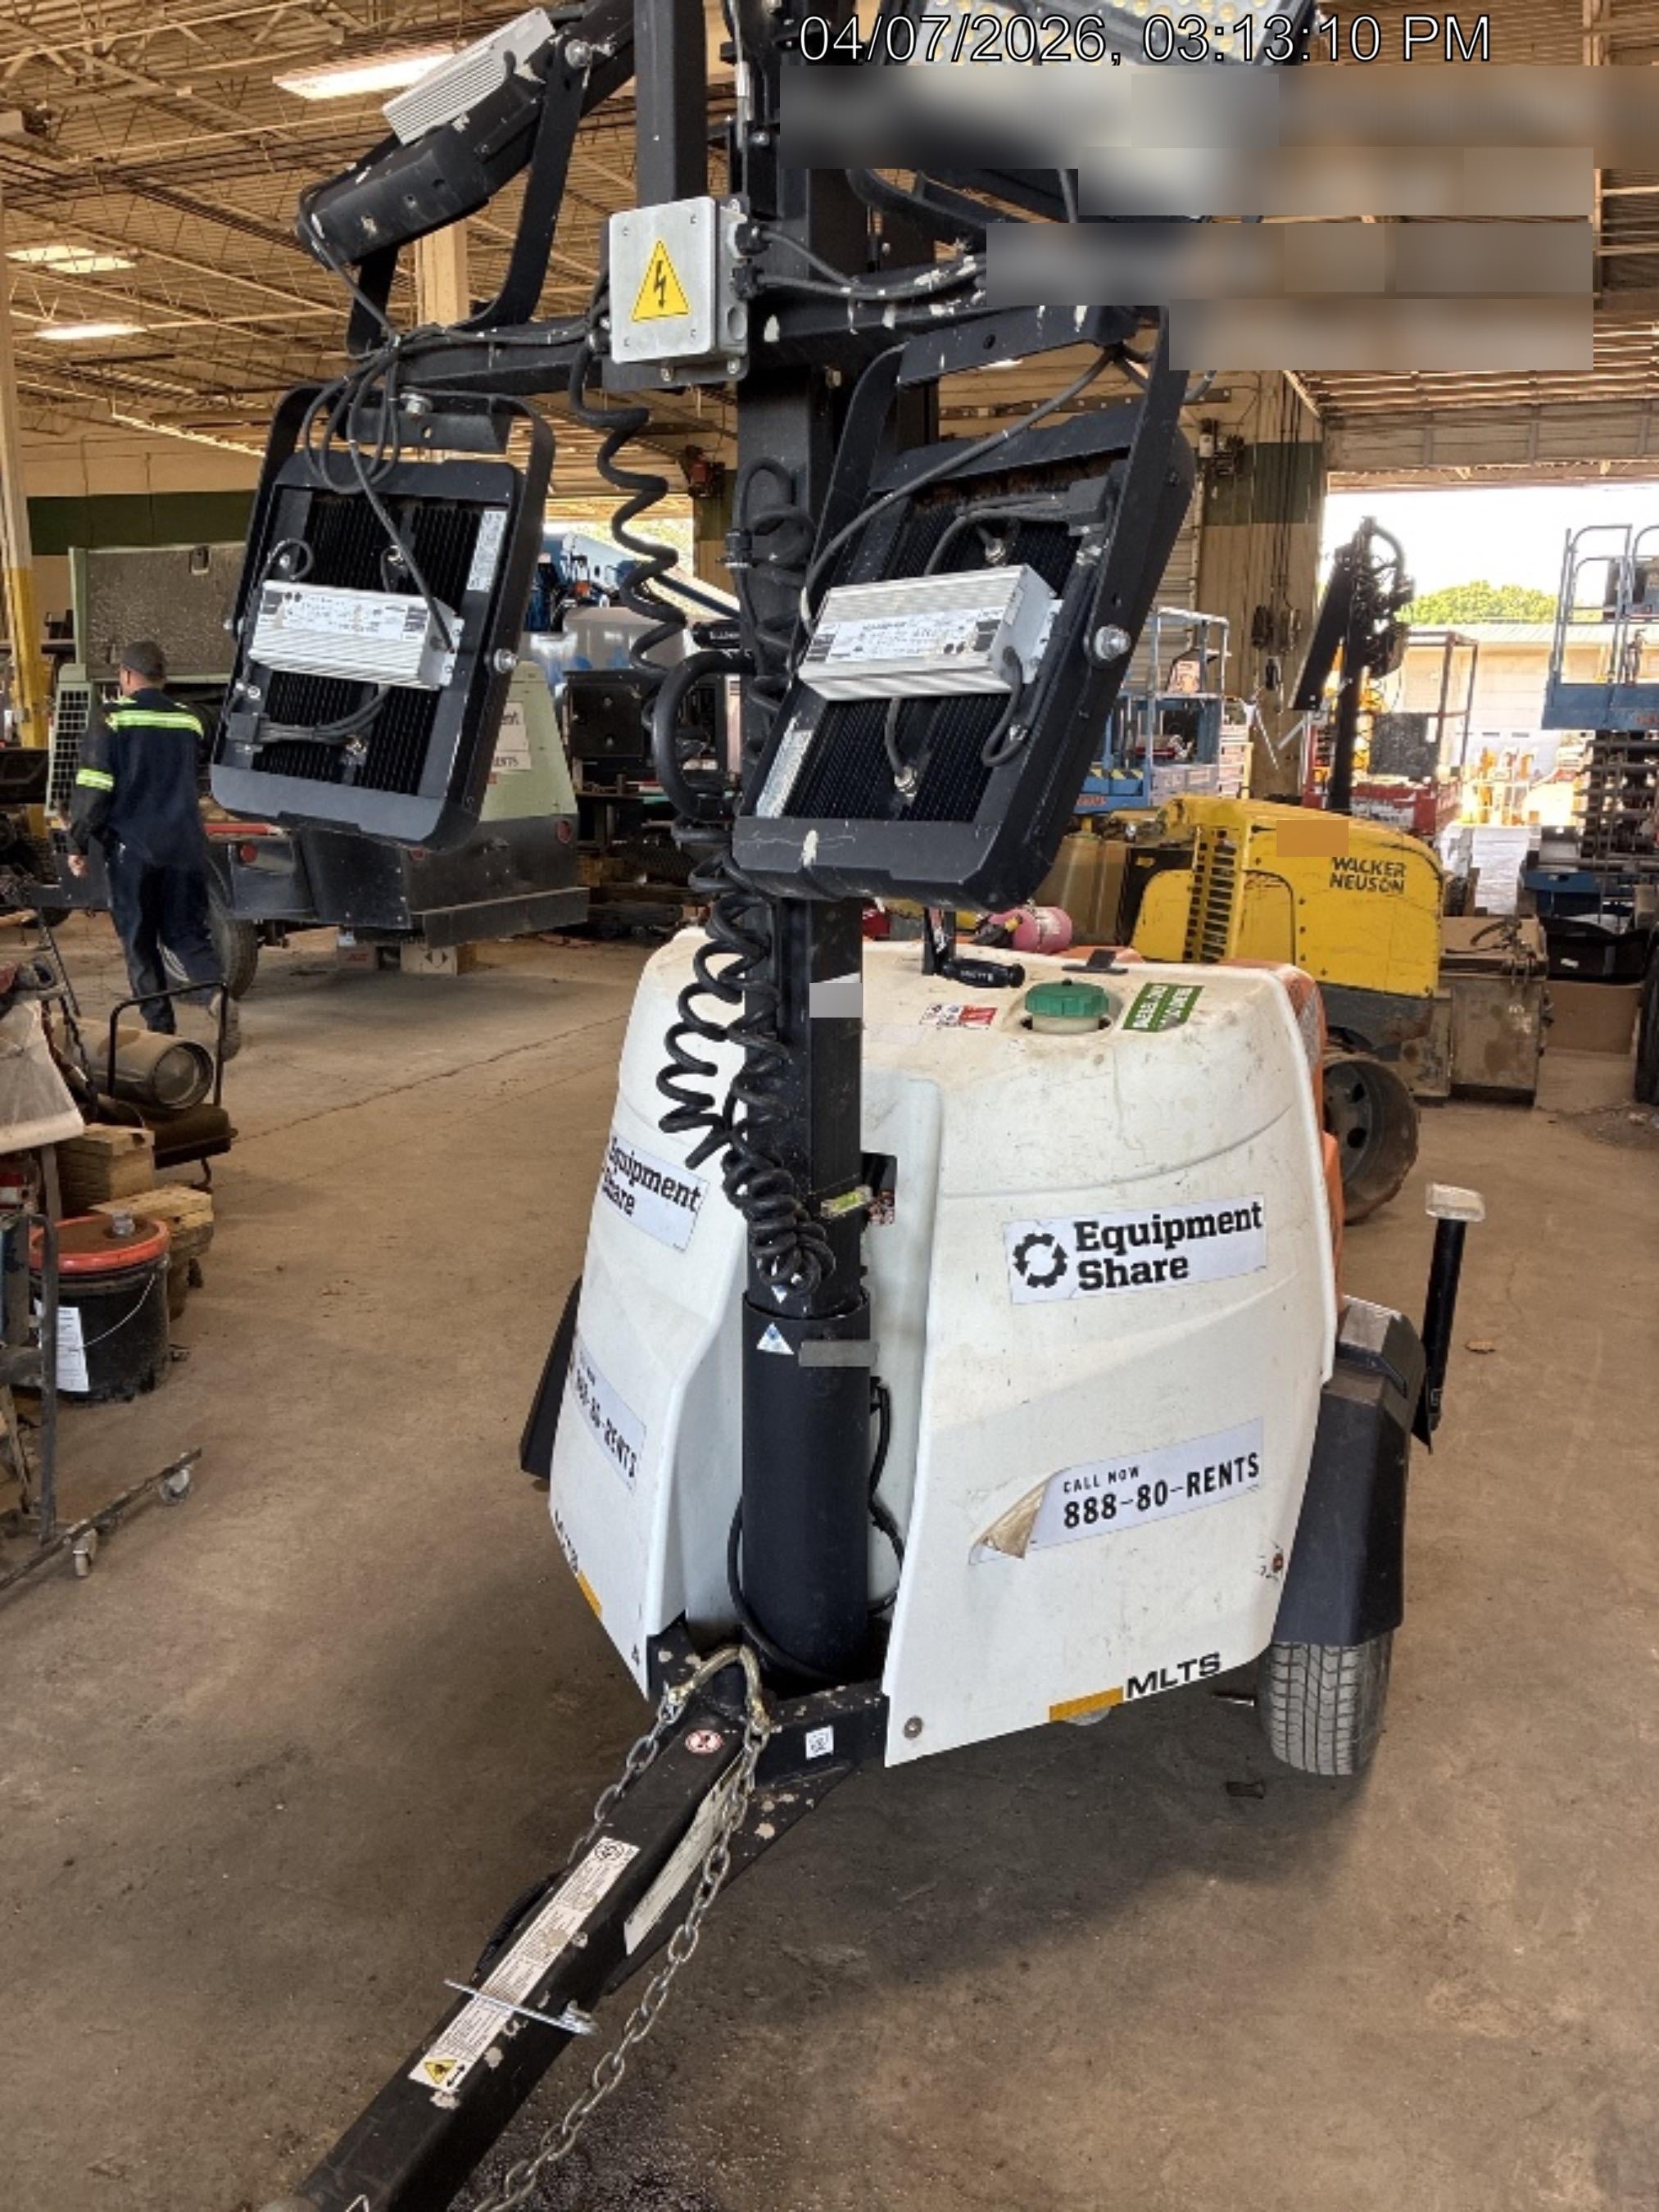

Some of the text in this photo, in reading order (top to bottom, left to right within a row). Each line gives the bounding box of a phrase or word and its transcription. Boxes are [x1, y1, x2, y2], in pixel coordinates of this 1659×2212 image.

[1330, 872, 1404, 894] NEUSON
[1331, 857, 1407, 877] WACKER
[1073, 1201, 1262, 1256] Equipment
[1077, 1257, 1189, 1290] Share
[1063, 1465, 1140, 1494] CALL NOW
[1063, 1451, 1260, 1530] 888-80-RENTS
[1126, 1651, 1220, 1698] MLTS
